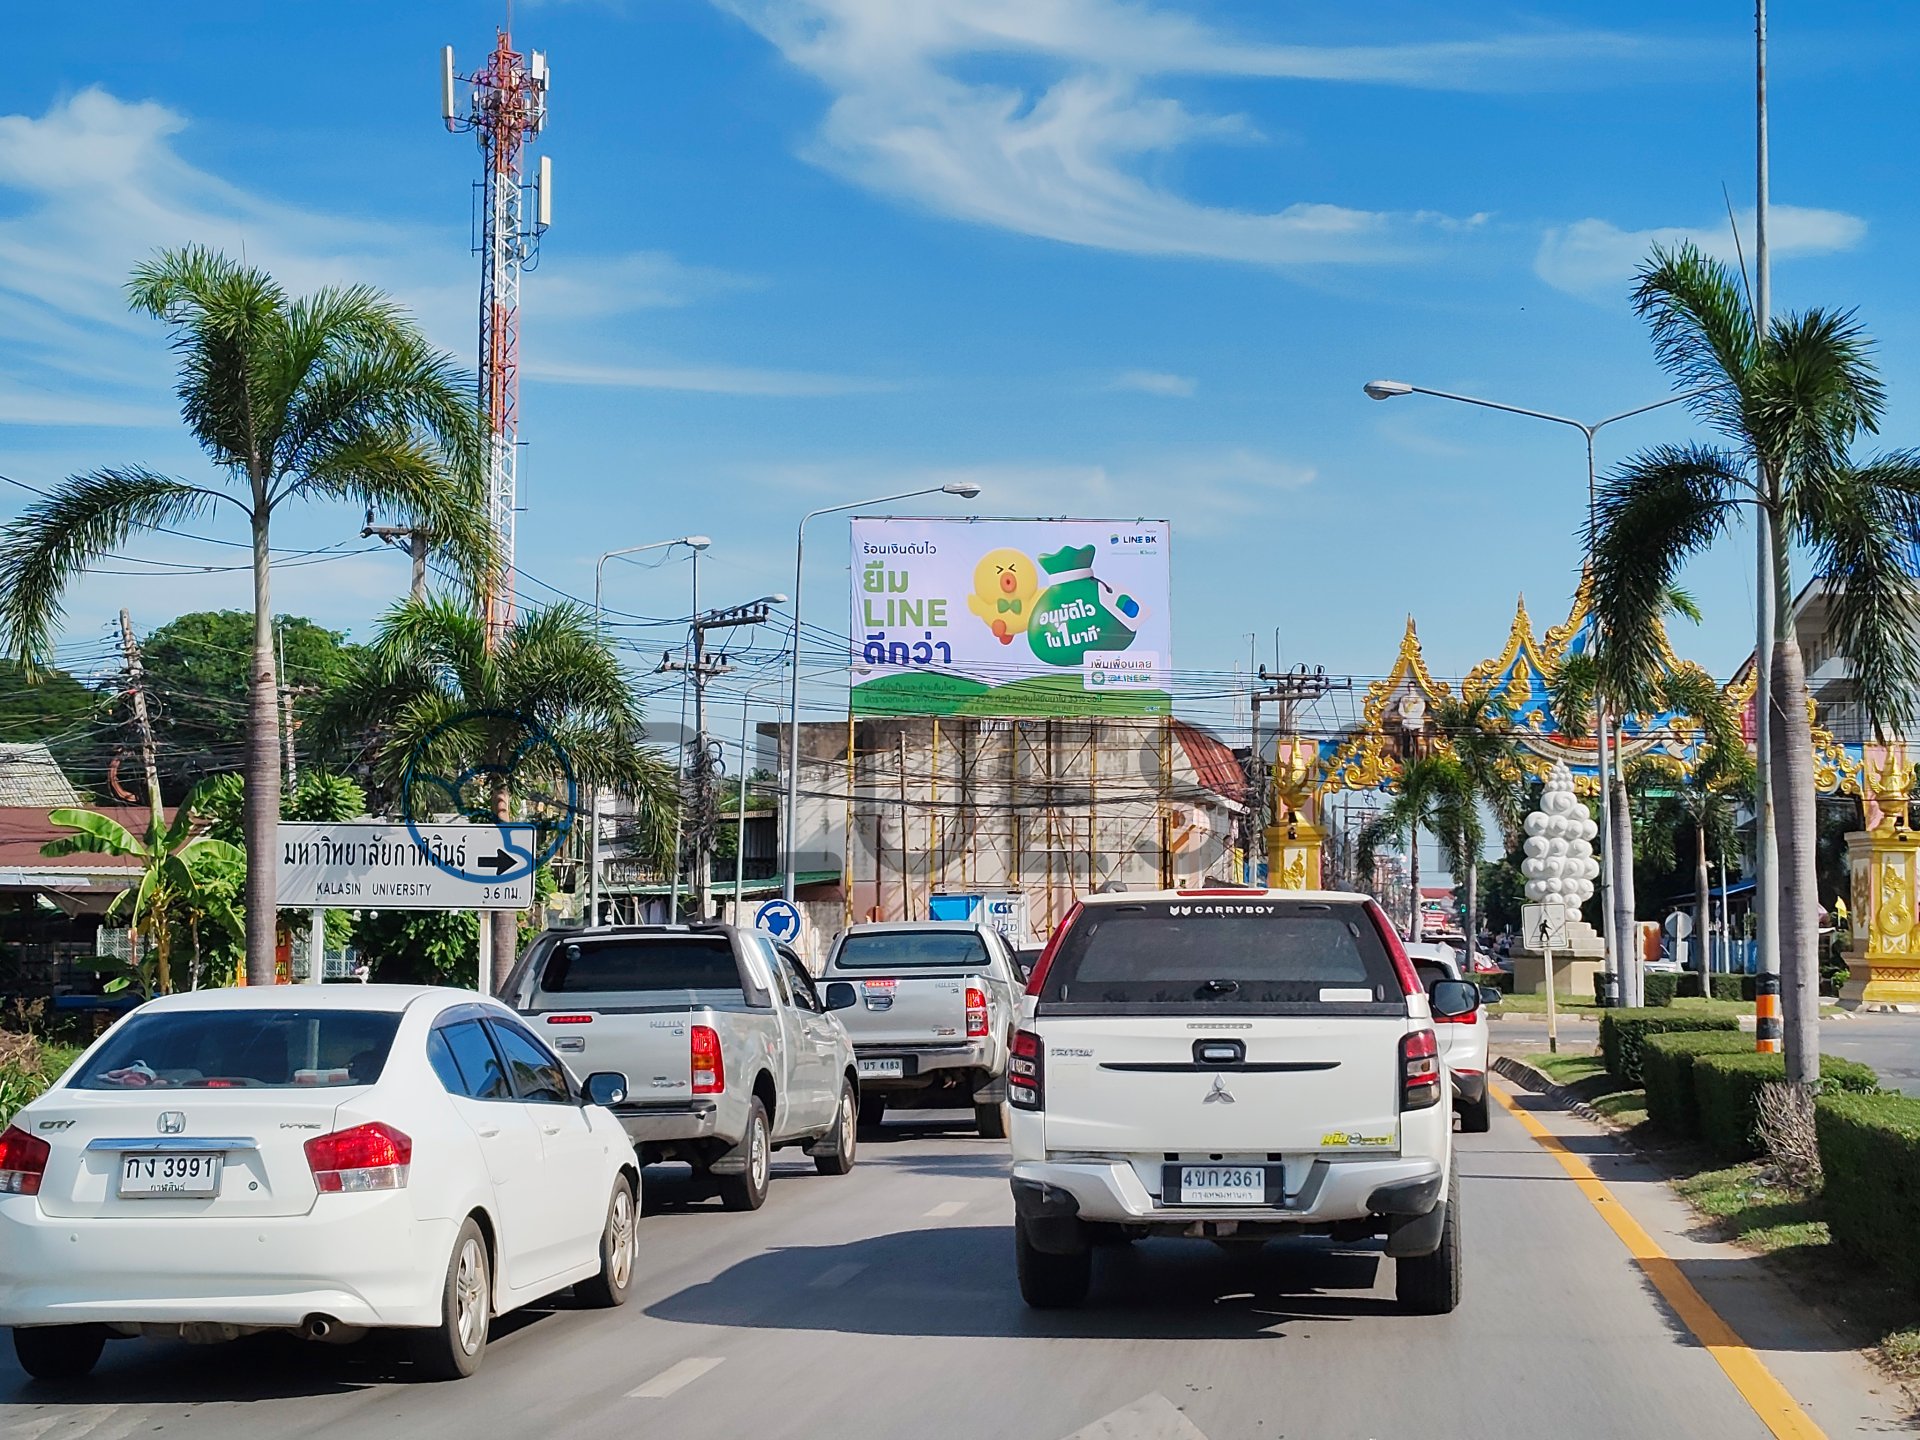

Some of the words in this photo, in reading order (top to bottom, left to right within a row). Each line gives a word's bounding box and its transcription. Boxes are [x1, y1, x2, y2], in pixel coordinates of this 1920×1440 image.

[863, 541, 937, 554] ร้อนเงินดับไว
[1123, 536, 1143, 544] LINE
[1145, 536, 1157, 544] BK
[863, 560, 909, 594] ยืม
[863, 598, 948, 627] LINE
[1039, 598, 1096, 629] อนุมัติไว
[1044, 631, 1061, 648] ใน
[1057, 622, 1071, 647] 1
[863, 631, 952, 664] ดีกว่า
[283, 835, 468, 877] มหาวิทยาลัยกาฬสินธุ์
[316, 883, 361, 896] KALASIN
[372, 883, 432, 896] UNIVERSITY
[483, 887, 501, 900] 3.6
[504, 887, 522, 900] กม.
[1194, 906, 1275, 914] CARRYBOY
[163, 1157, 212, 1178] 3991
[1222, 1170, 1261, 1187] 2361
